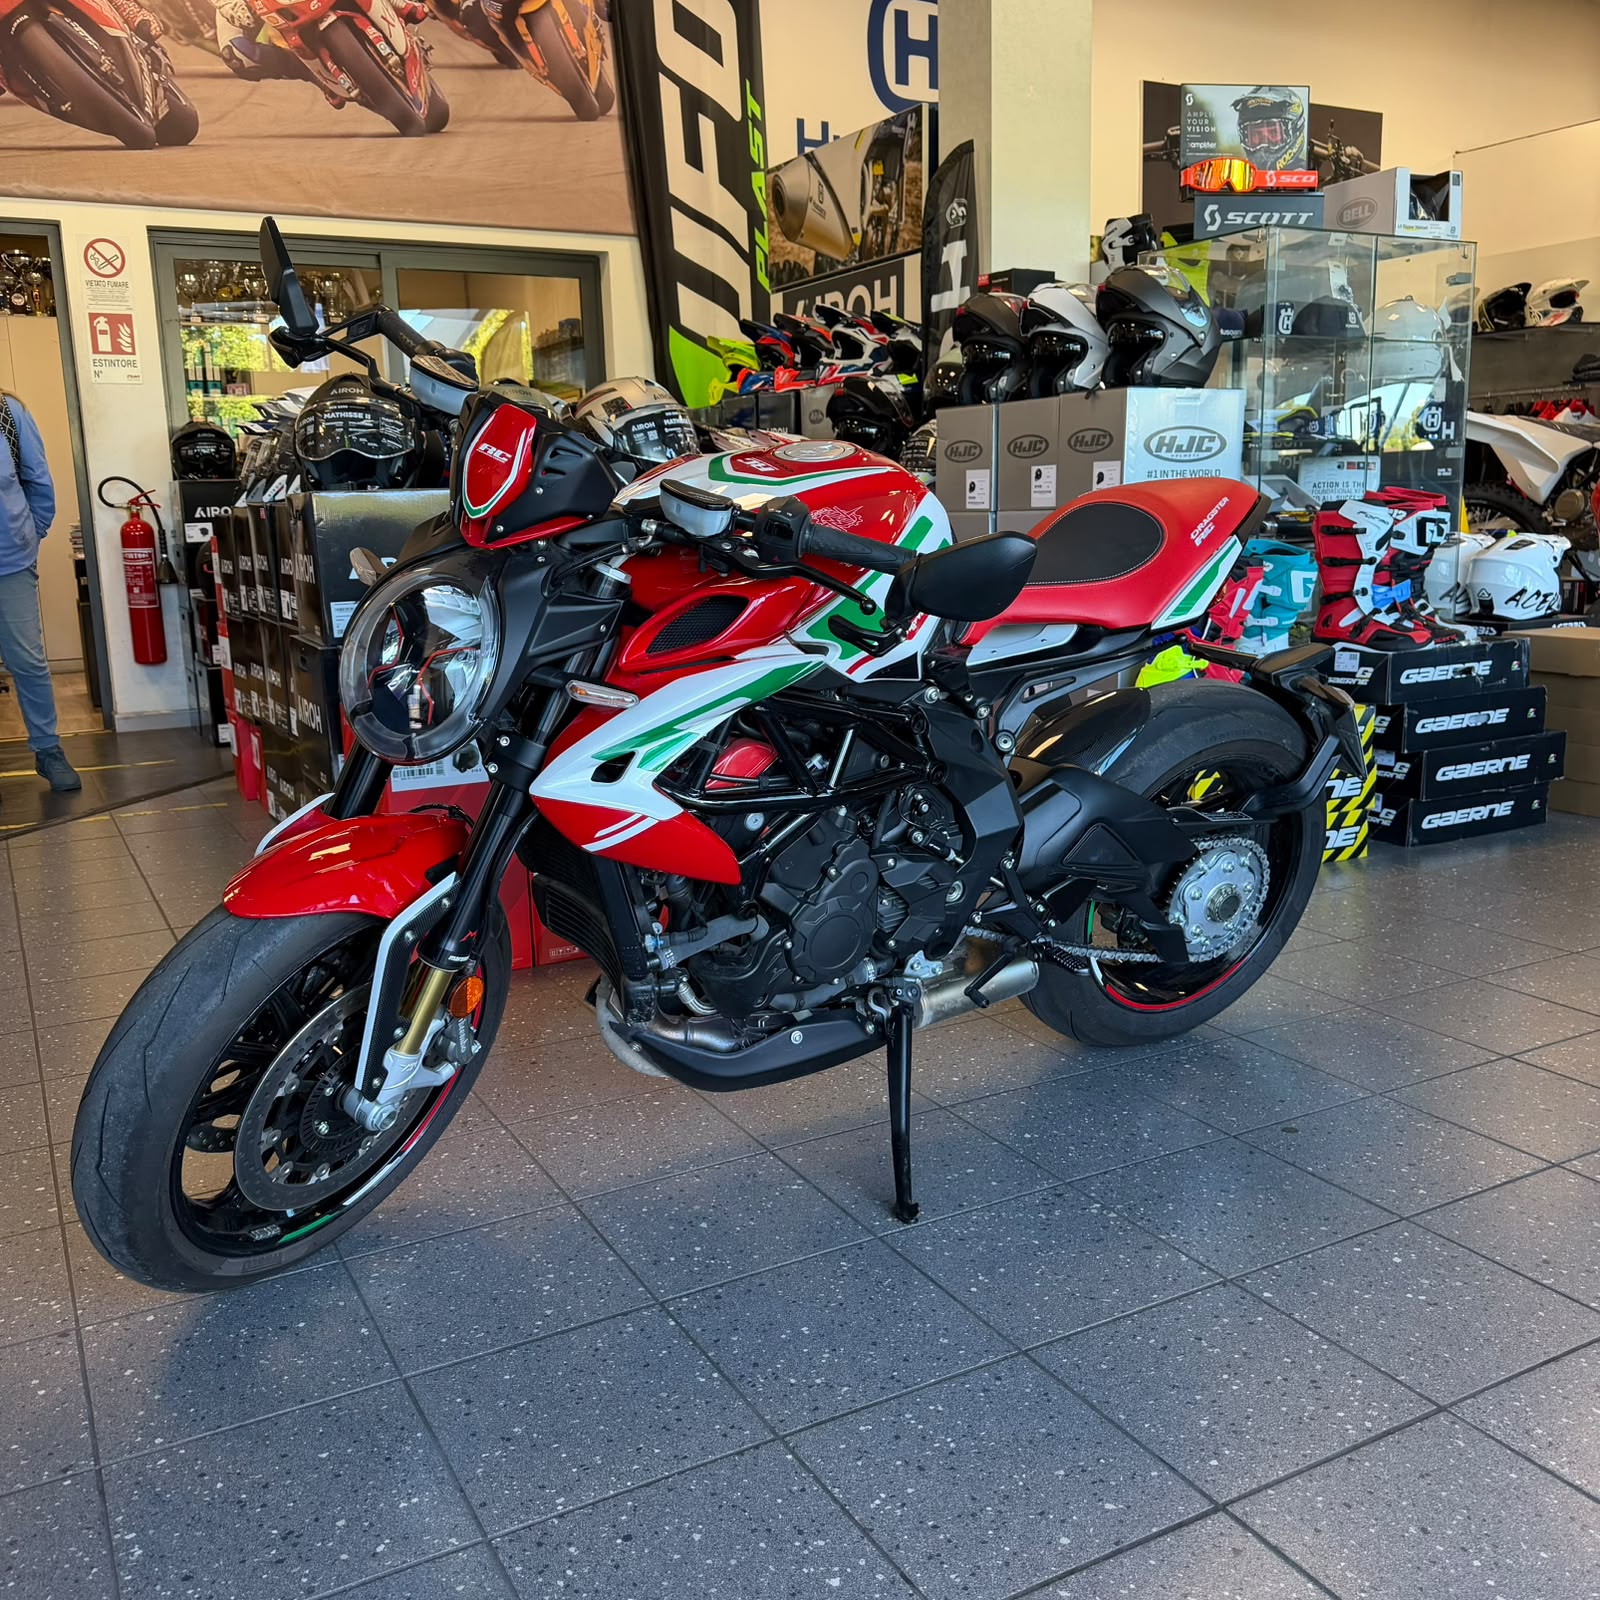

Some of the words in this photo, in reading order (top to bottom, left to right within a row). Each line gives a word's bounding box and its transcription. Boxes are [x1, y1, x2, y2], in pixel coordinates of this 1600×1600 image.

[746, 79, 771, 295] PLAST
[1224, 212, 1314, 225] SCOTT
[1342, 203, 1372, 223] BELL
[86, 280, 106, 288] VIETATO
[92, 359, 138, 368] ESTINTORE
[330, 387, 364, 396] AIROH
[631, 421, 656, 432] AIROH
[1012, 438, 1044, 453] HJC
[1074, 432, 1109, 448] HJC
[1154, 435, 1217, 453] HJC
[949, 445, 978, 457] HJC
[1147, 470, 1158, 479] #1
[1160, 470, 1169, 479] IN
[1171, 469, 1187, 478] THE
[1189, 468, 1221, 478] WORLD
[1312, 481, 1339, 489] ACTION
[1190, 496, 1230, 540] DRAGSTER
[295, 553, 316, 585] AIROH
[297, 694, 323, 735] AIROH
[1435, 753, 1532, 782] GAERNE
[1421, 800, 1515, 830] GAERNE
